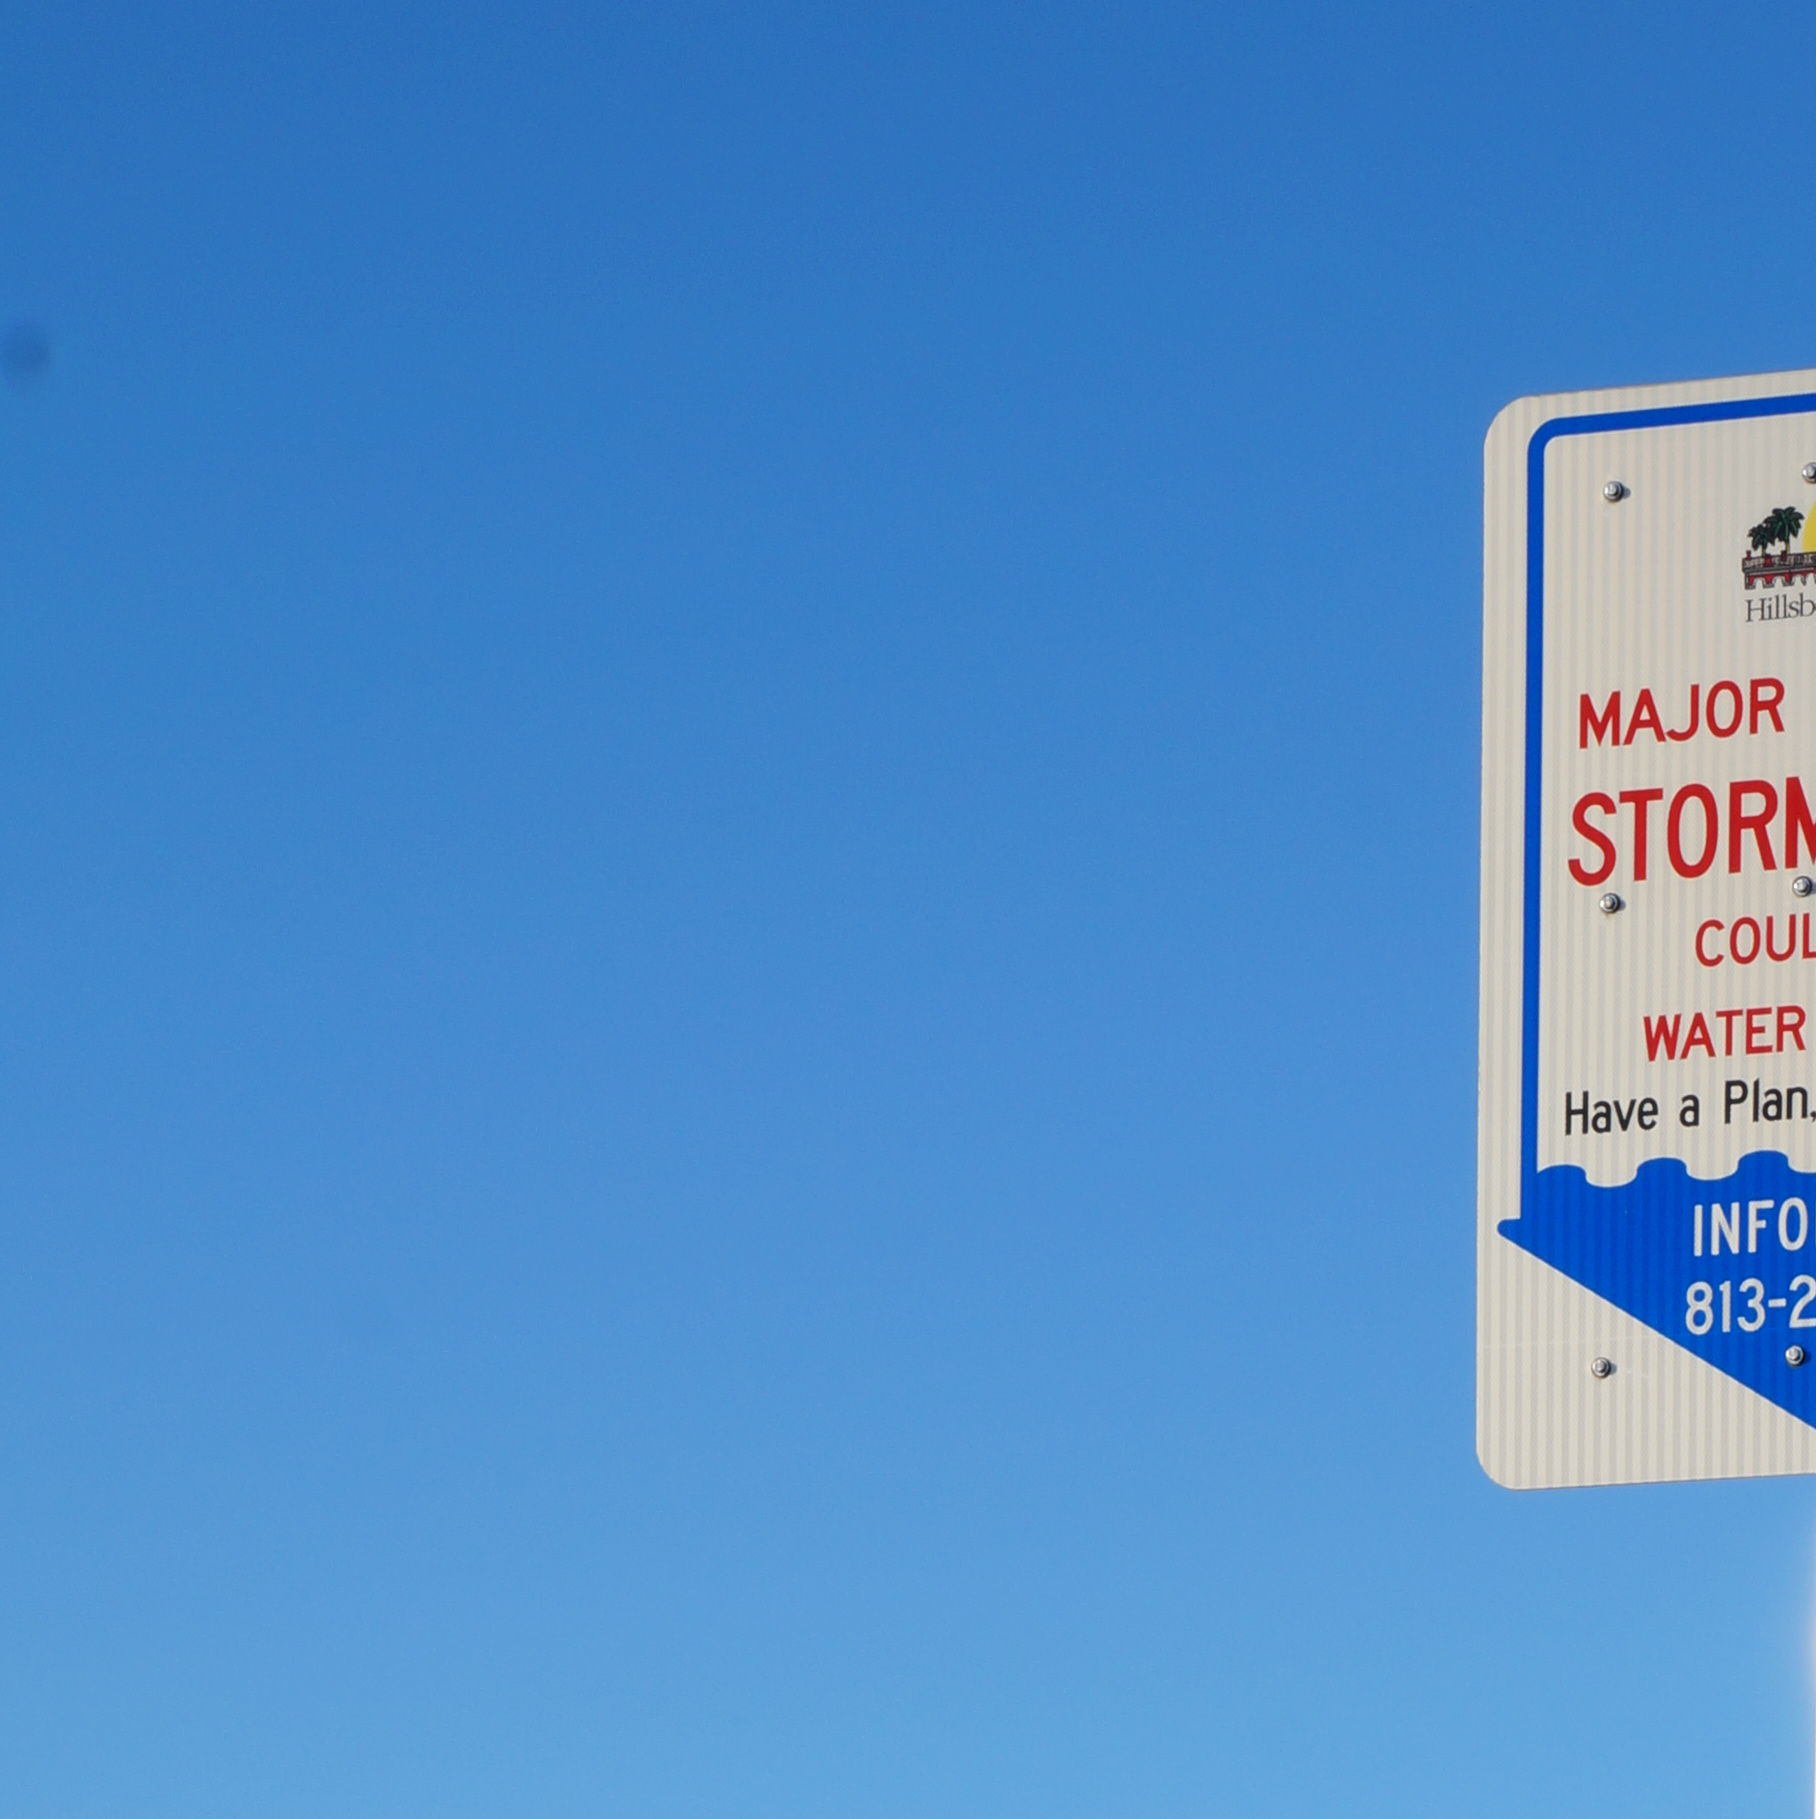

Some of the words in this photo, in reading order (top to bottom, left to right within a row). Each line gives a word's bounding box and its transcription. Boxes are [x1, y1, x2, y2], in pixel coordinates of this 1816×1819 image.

[1579, 677, 1784, 749] MAJOR
[1643, 1004, 1806, 1062] WATER
[1565, 1091, 1658, 1136] Have
[1679, 1095, 1700, 1127] a
